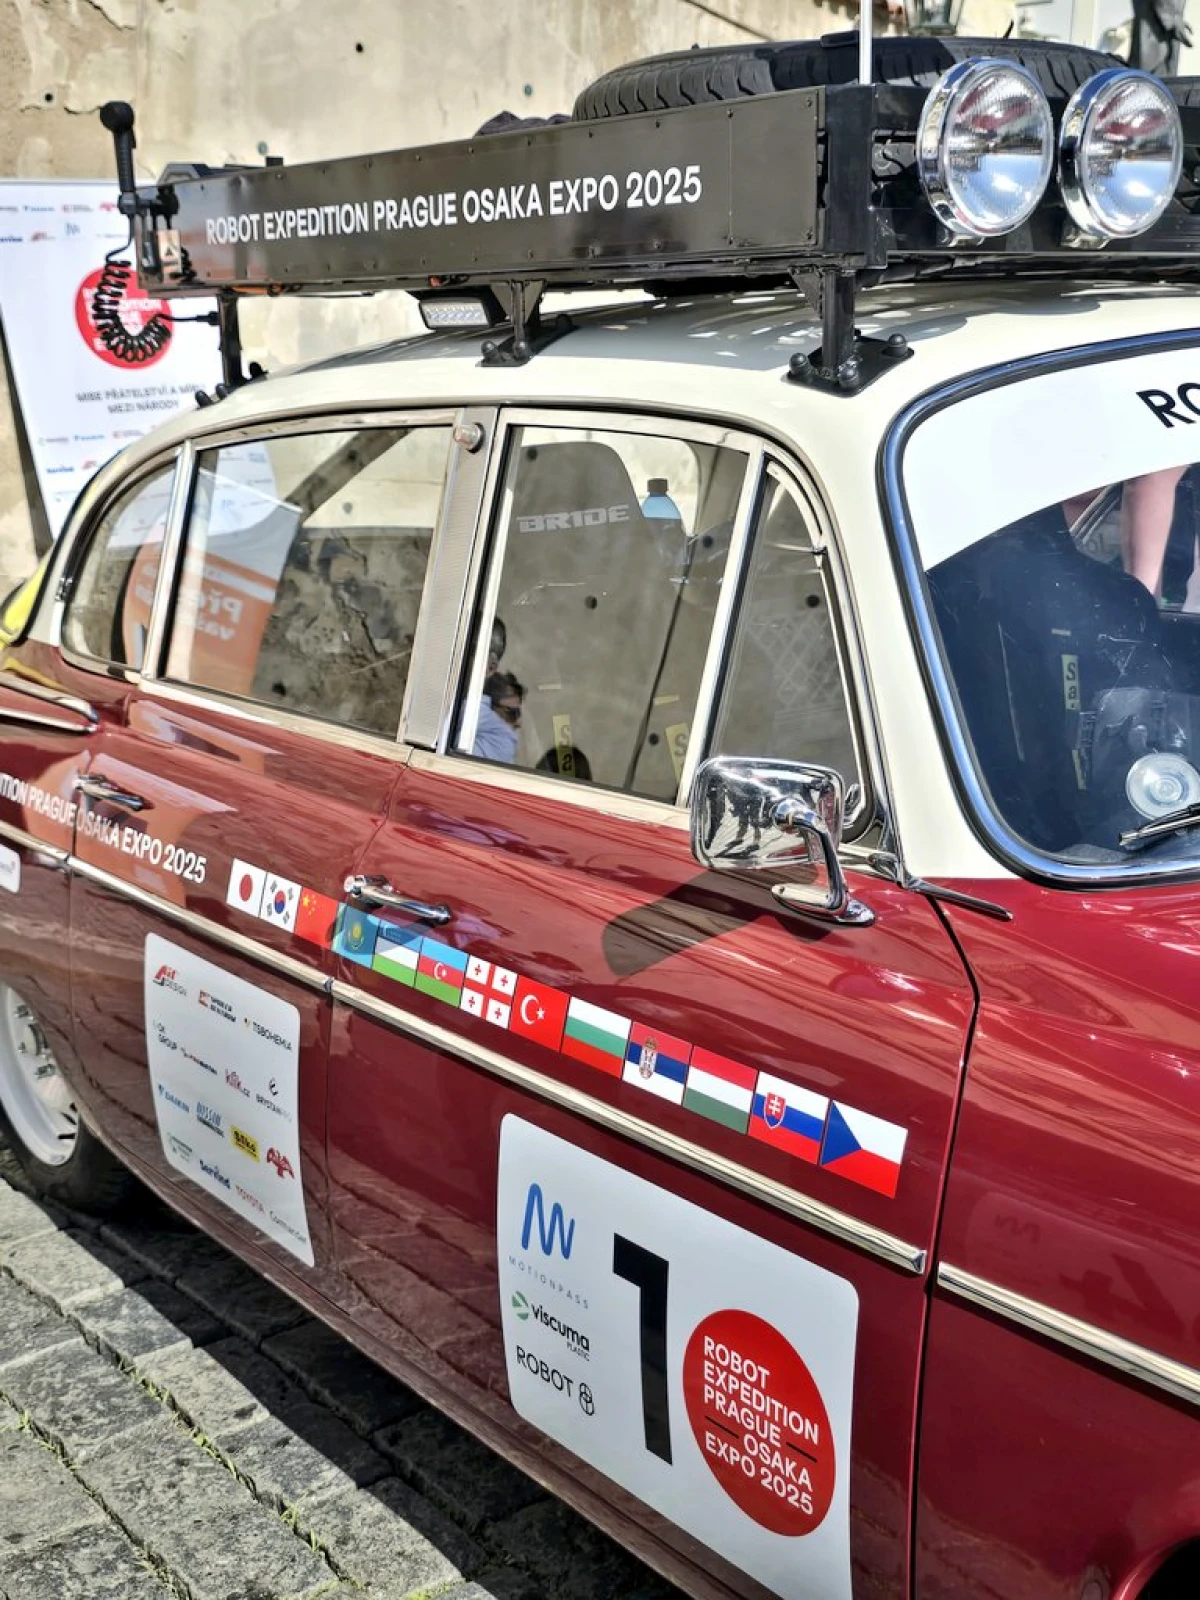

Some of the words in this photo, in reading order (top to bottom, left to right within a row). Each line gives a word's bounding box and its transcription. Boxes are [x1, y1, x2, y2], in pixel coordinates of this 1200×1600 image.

[206, 213, 260, 245] ROBOT
[263, 202, 368, 240] EXPEDITION
[372, 191, 458, 231] PRAGUE
[462, 183, 544, 224] OSAKA
[549, 174, 620, 215] EXPO
[626, 165, 702, 208] 2025
[515, 504, 631, 534] BRIDE
[27, 785, 77, 827] PRAGUE
[77, 808, 120, 849] OSAKA
[122, 826, 162, 865] EXPO
[162, 844, 207, 884] 2025
[508, 1255, 590, 1309] MOTIONPASS
[530, 1302, 590, 1352] viscuma
[612, 1232, 673, 1467] 1
[516, 1345, 574, 1398] ROBOT
[703, 1335, 770, 1389] ROBOT
[703, 1360, 820, 1446] EXPEDITION
[703, 1385, 782, 1448] PRAGUE
[705, 1431, 756, 1478] EXPO
[760, 1469, 814, 1515] 2025
[743, 1433, 814, 1493] OSAKA
